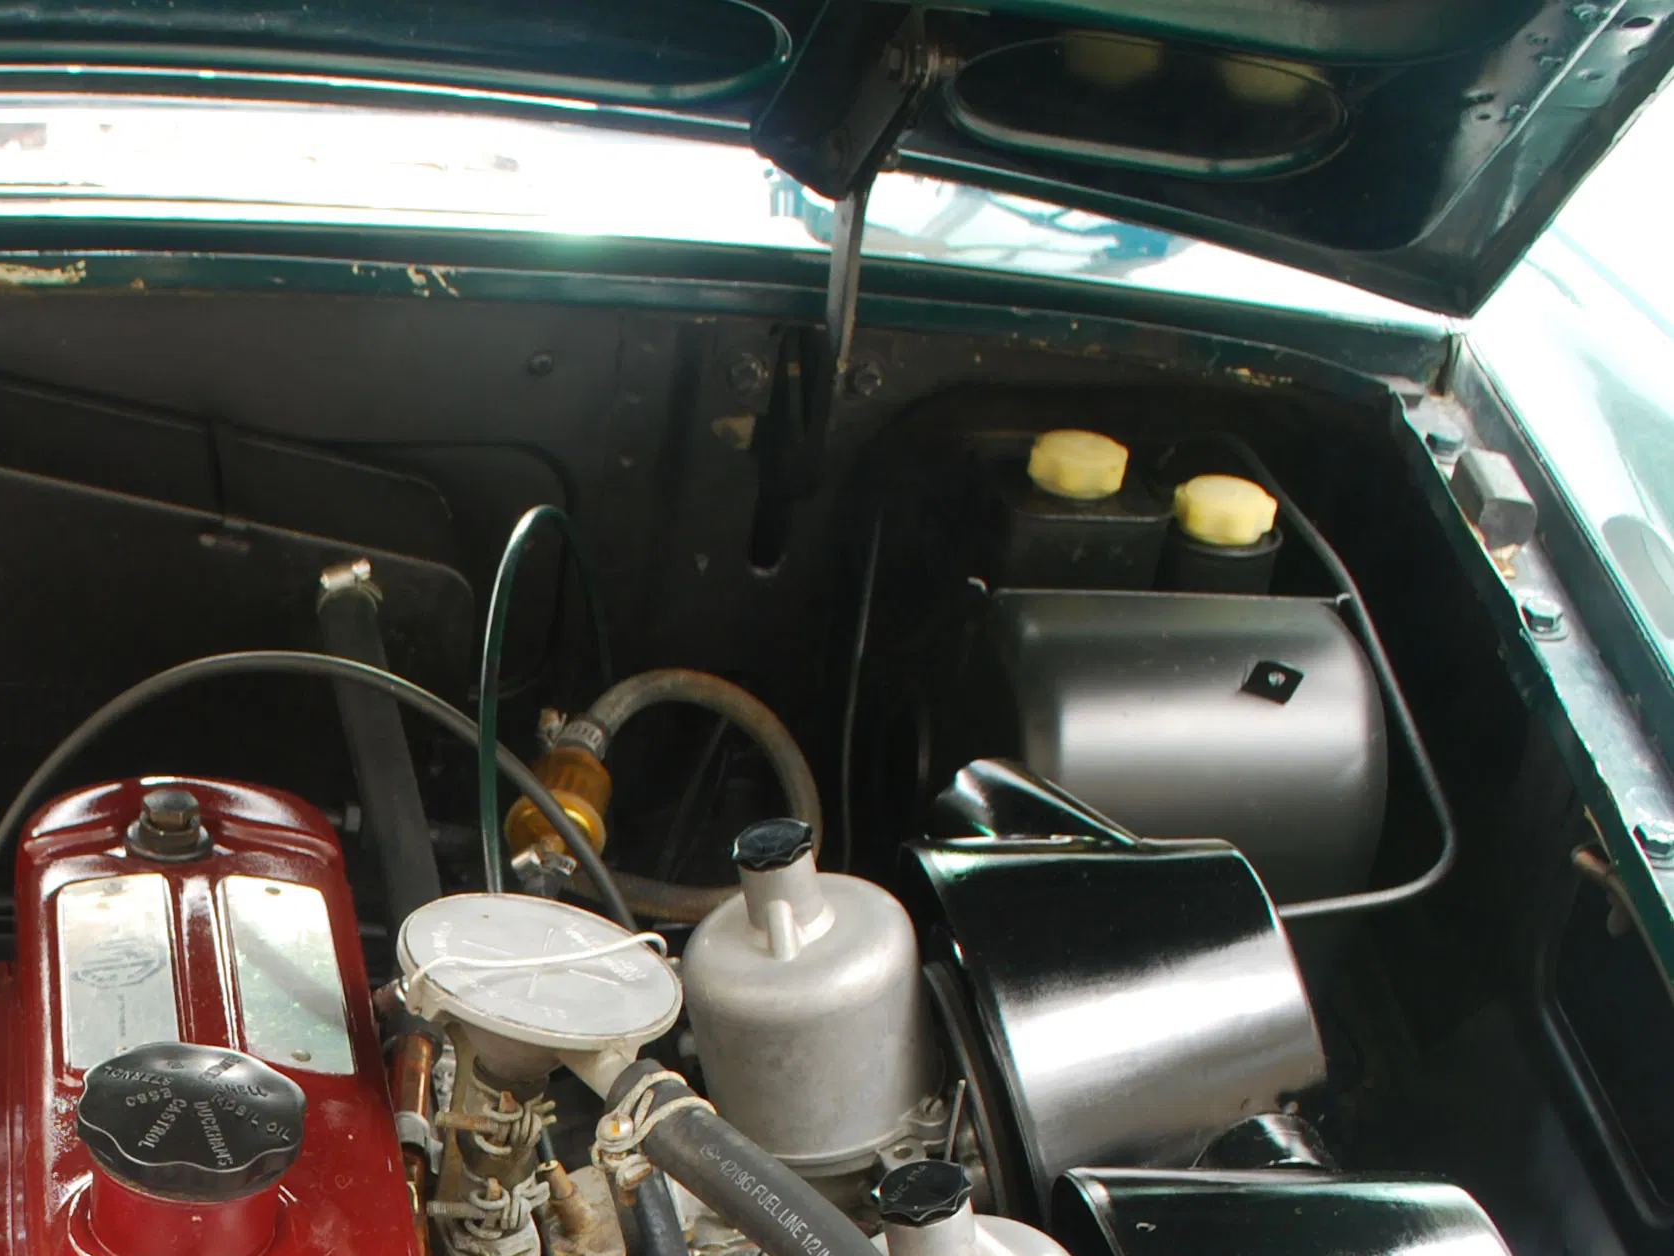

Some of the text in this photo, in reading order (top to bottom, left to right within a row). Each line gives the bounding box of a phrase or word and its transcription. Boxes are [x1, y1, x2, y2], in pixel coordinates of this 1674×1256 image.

[215, 1083, 268, 1097] SHELL
[137, 1098, 188, 1148] CASTROL
[193, 1101, 234, 1166] DUCKHAMS
[267, 1122, 290, 1143] OIL
[750, 1184, 782, 1217] FUEL
[777, 1207, 808, 1239] LINE
[801, 1232, 822, 1255] 1/2
